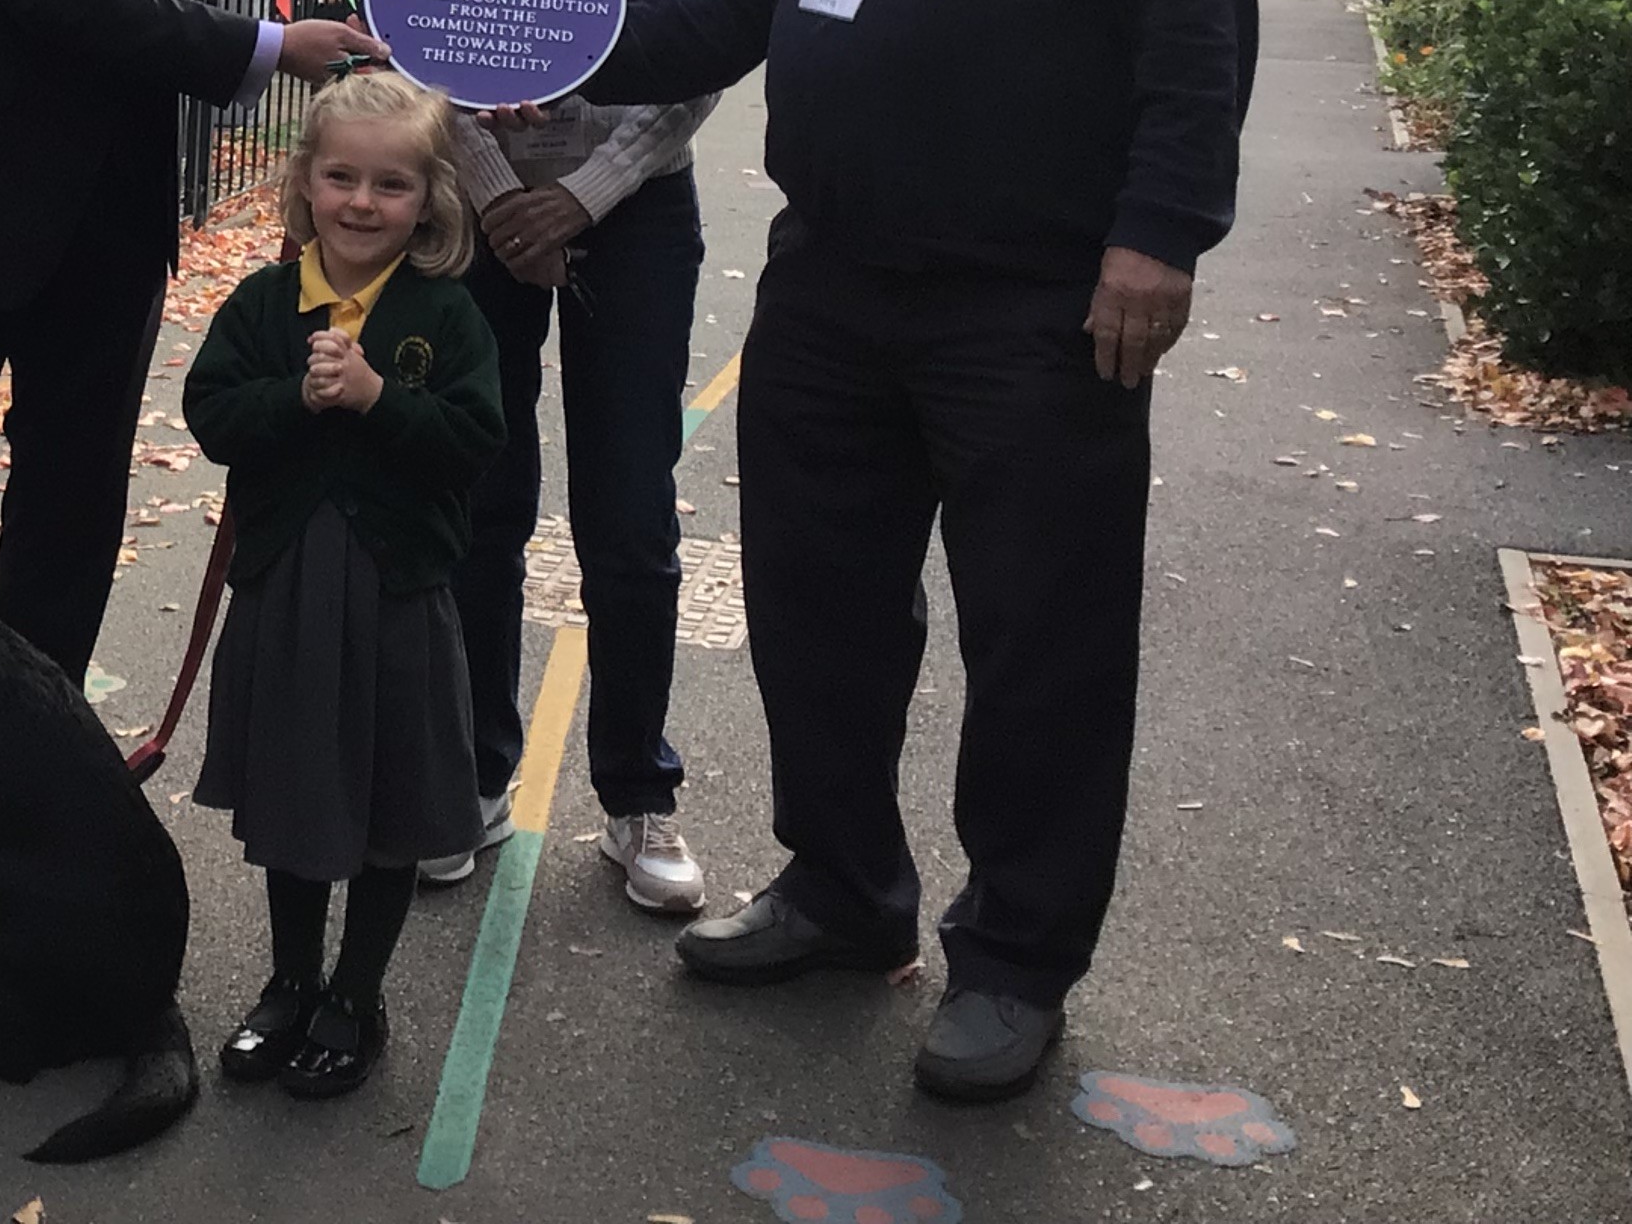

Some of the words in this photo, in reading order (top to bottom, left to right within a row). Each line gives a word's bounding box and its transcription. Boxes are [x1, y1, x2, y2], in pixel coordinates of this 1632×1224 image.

[449, 4, 498, 20] FROM
[501, 8, 537, 24] THE
[407, 15, 521, 37] COMMUNITY
[523, 27, 574, 42] FUND
[445, 34, 533, 55] TOWARDS
[422, 47, 465, 64] THIS
[468, 52, 552, 72] FACILITY
